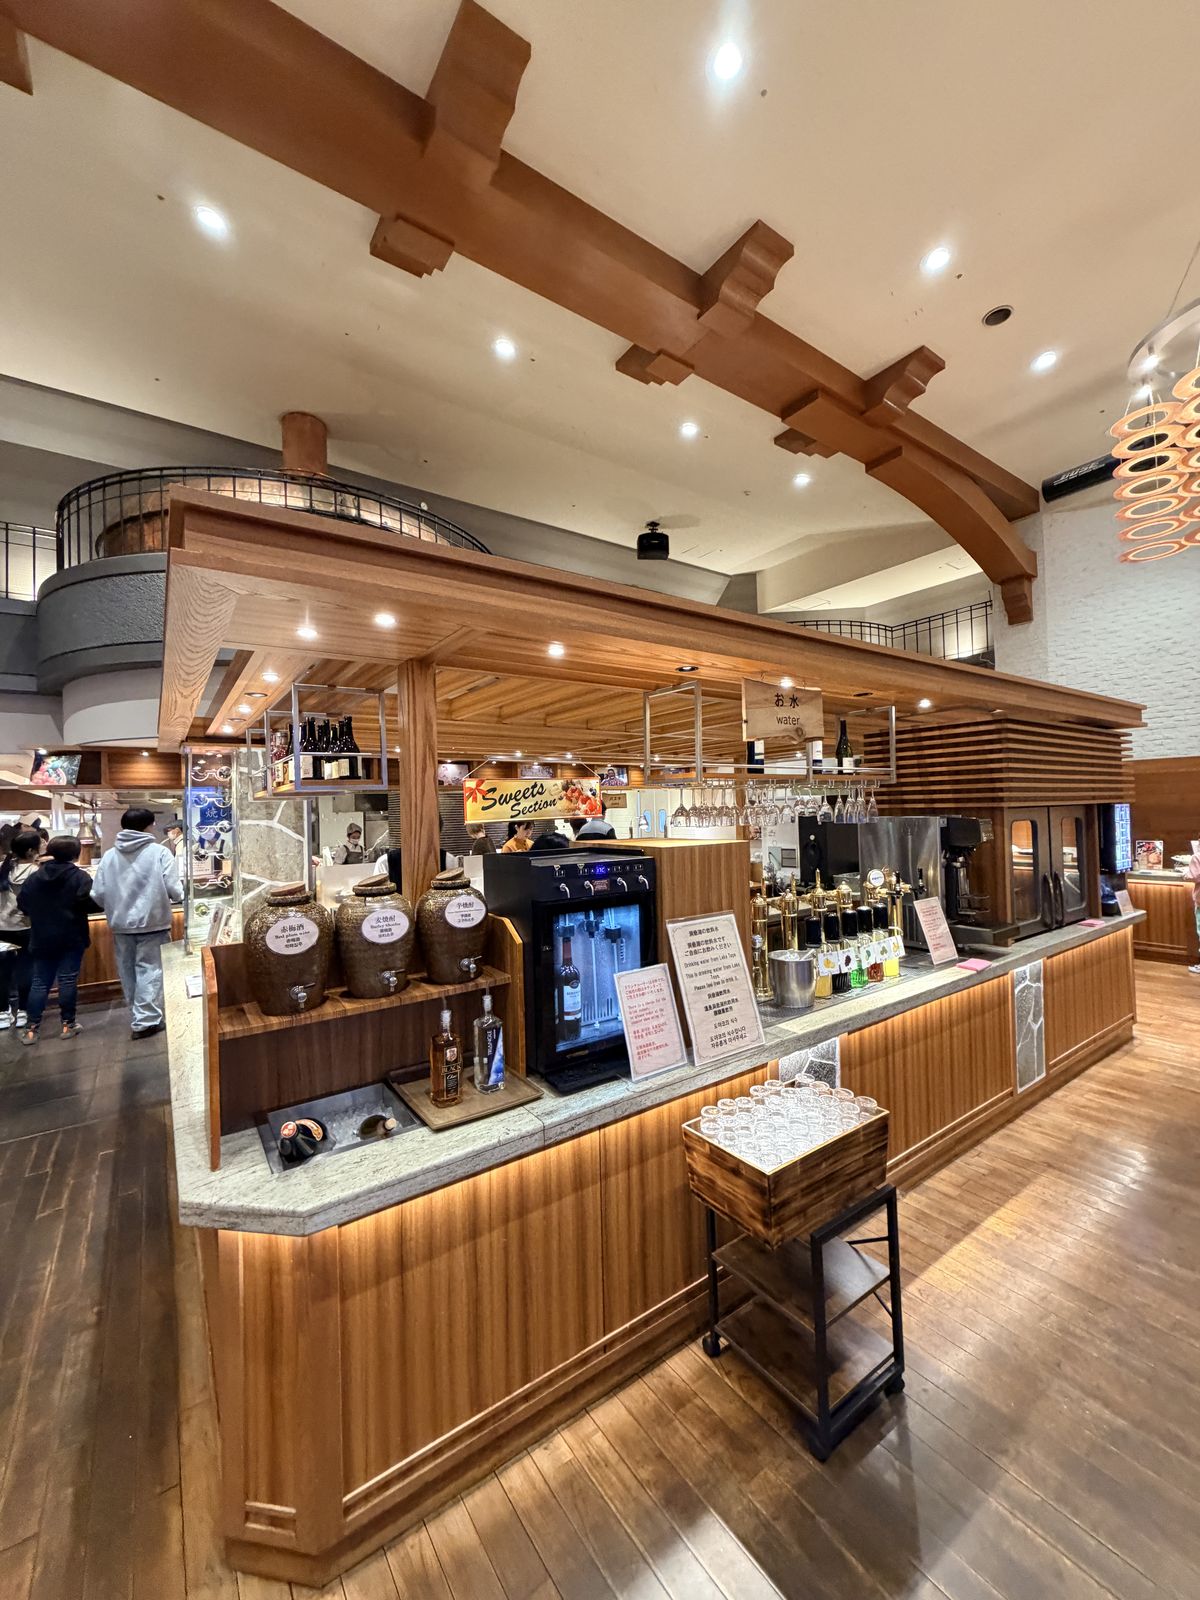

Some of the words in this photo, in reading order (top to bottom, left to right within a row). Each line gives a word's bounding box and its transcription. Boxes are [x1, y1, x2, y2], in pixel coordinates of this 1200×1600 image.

[776, 715, 800, 725] water
[481, 782, 546, 811] Sweets
[510, 798, 557, 818] Section
[684, 960, 700, 969] Drinking
